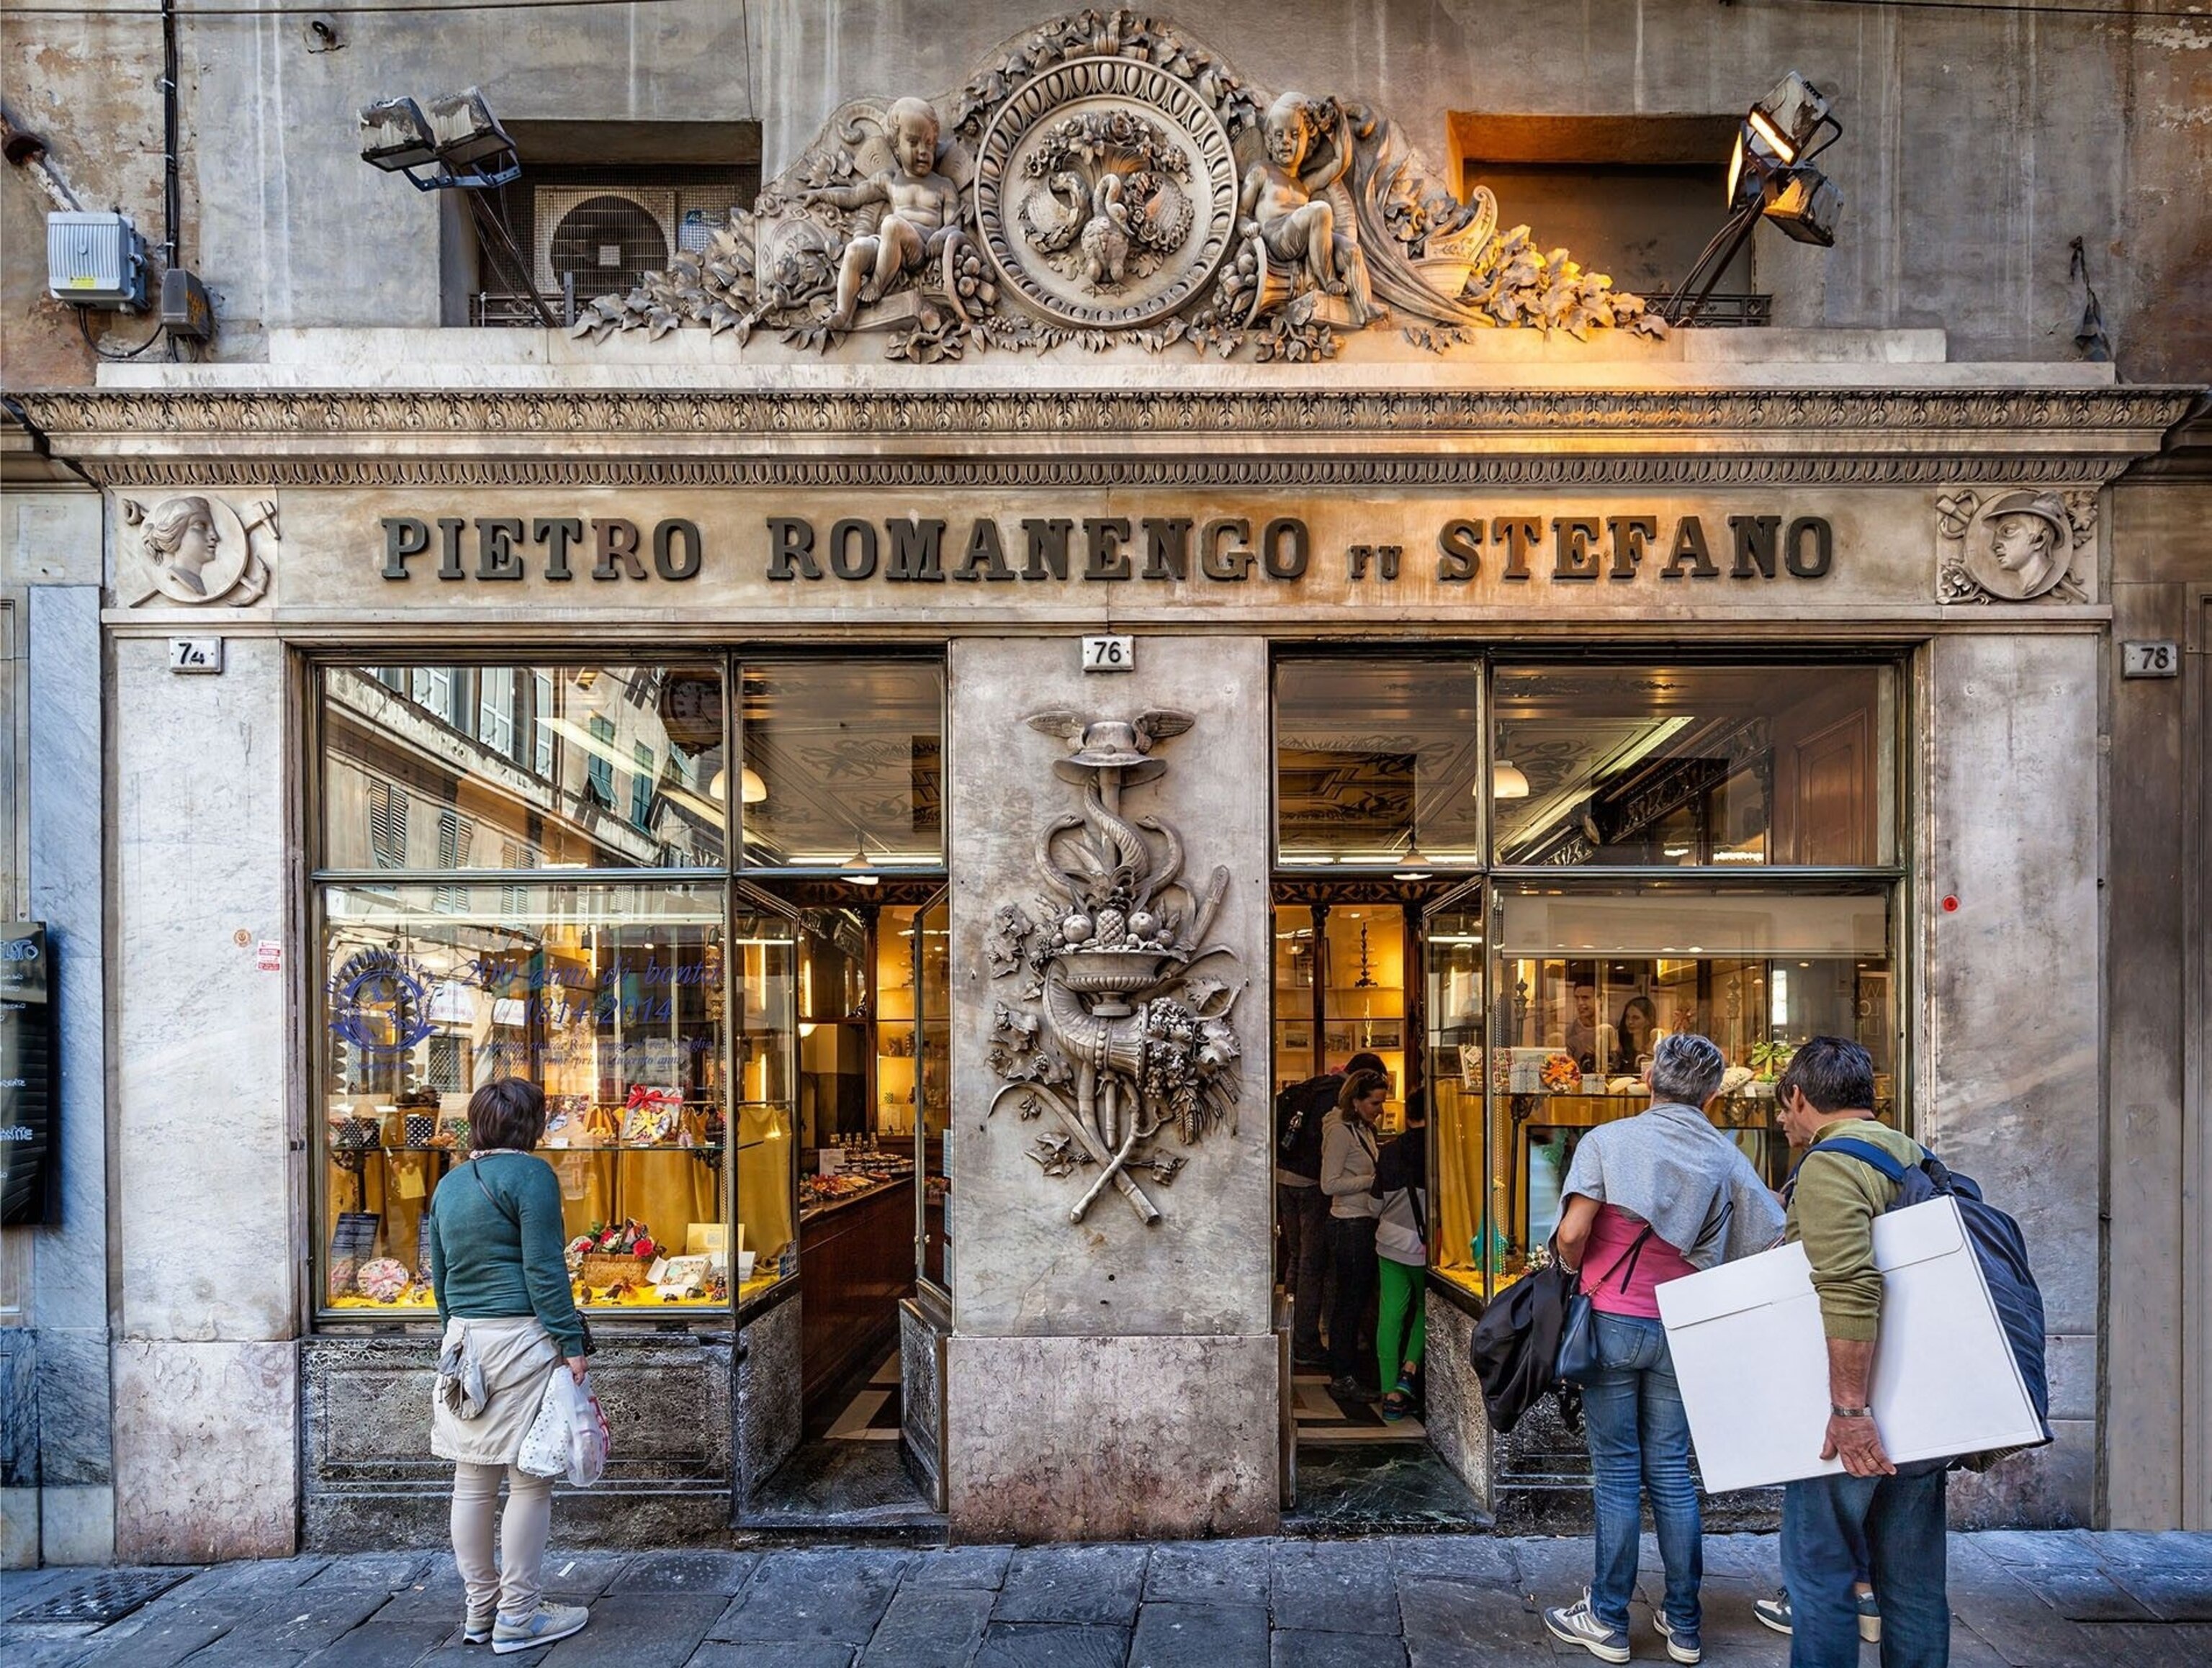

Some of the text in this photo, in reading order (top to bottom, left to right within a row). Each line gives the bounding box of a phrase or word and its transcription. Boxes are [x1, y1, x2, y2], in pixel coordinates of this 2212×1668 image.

[381, 517, 703, 581] PIETRO
[766, 516, 1310, 582] ROMANENGO
[1437, 515, 1833, 581] STEFANO
[178, 642, 205, 665] 74
[1094, 641, 1122, 664] 76
[2141, 646, 2169, 670] 78
[461, 959, 518, 986] 200
[529, 967, 589, 986] anni
[602, 955, 631, 986] di
